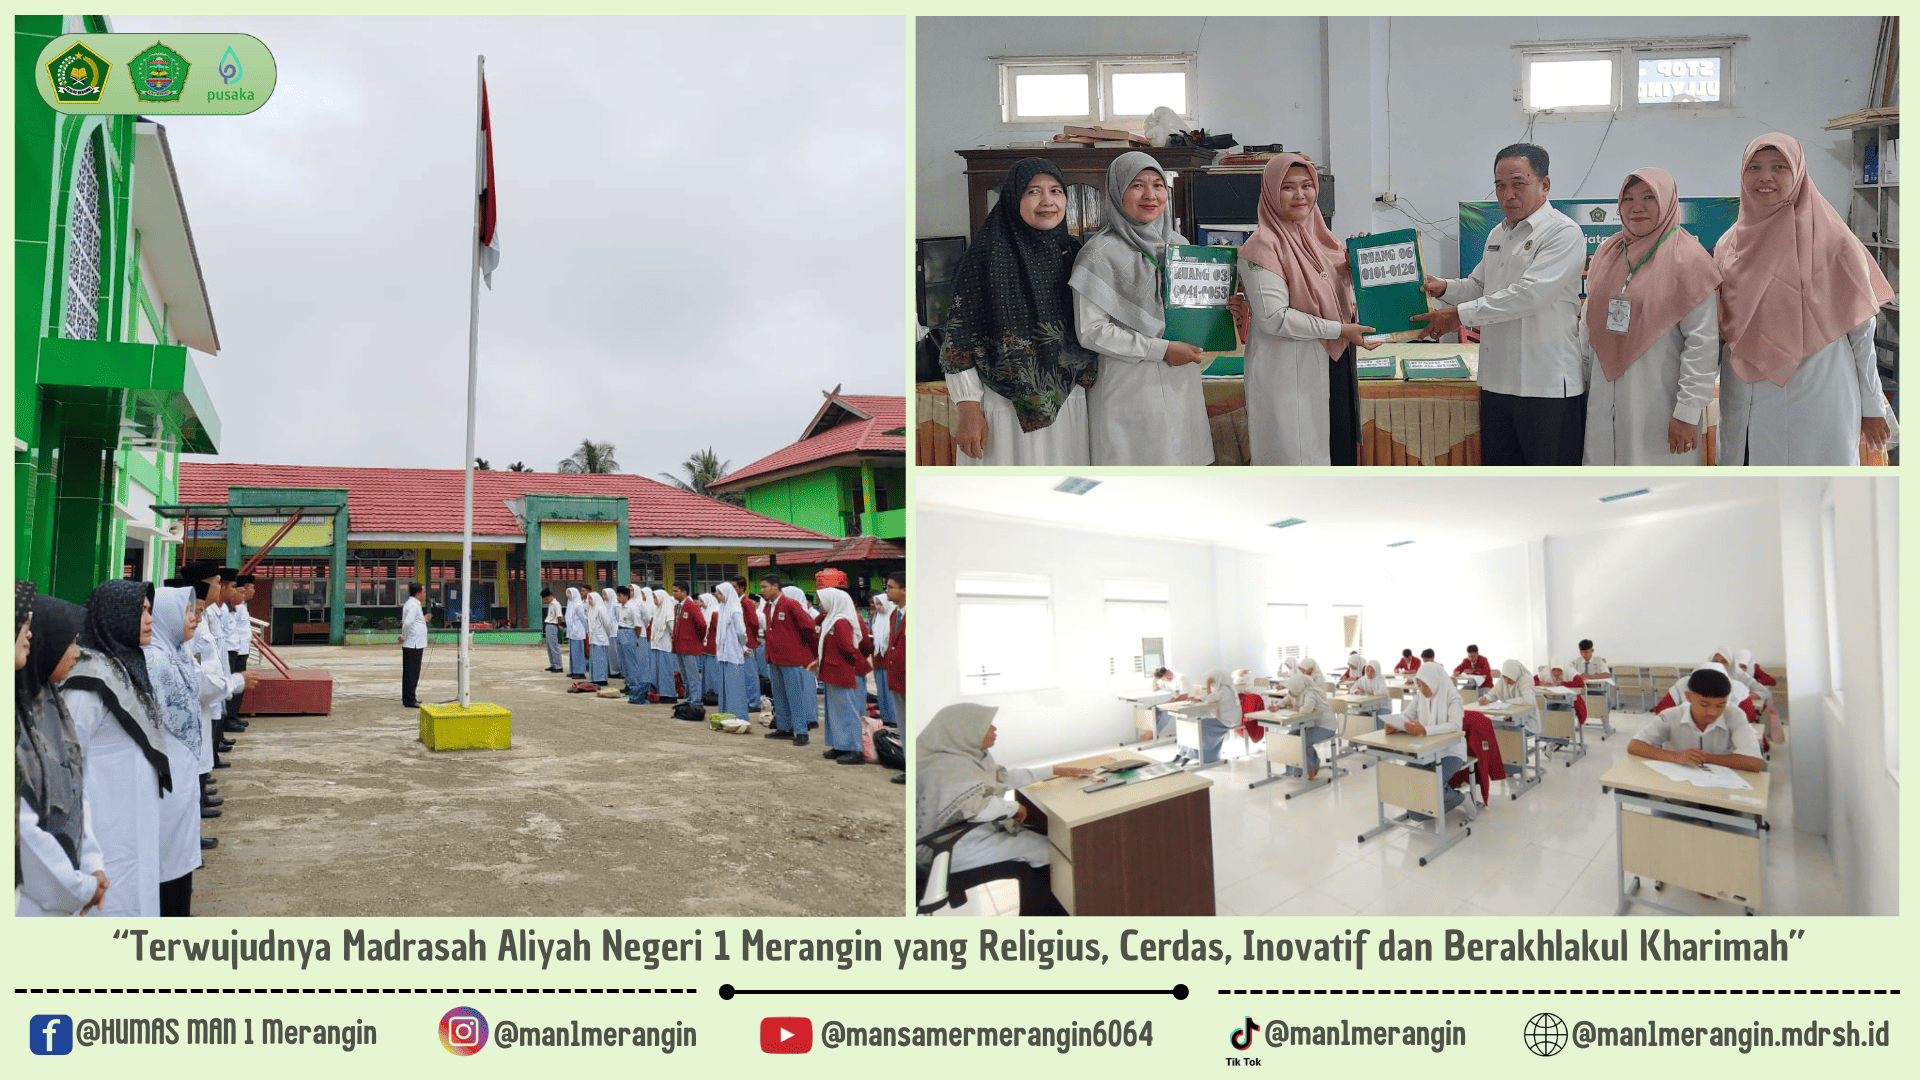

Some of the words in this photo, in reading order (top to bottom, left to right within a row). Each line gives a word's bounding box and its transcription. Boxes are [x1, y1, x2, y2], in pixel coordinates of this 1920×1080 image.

[1359, 249, 1396, 264] RUANG
[1398, 246, 1414, 260] 06
[1173, 267, 1210, 281] RUANG
[1212, 268, 1228, 282] 03
[1361, 261, 1416, 280] 0101-0126
